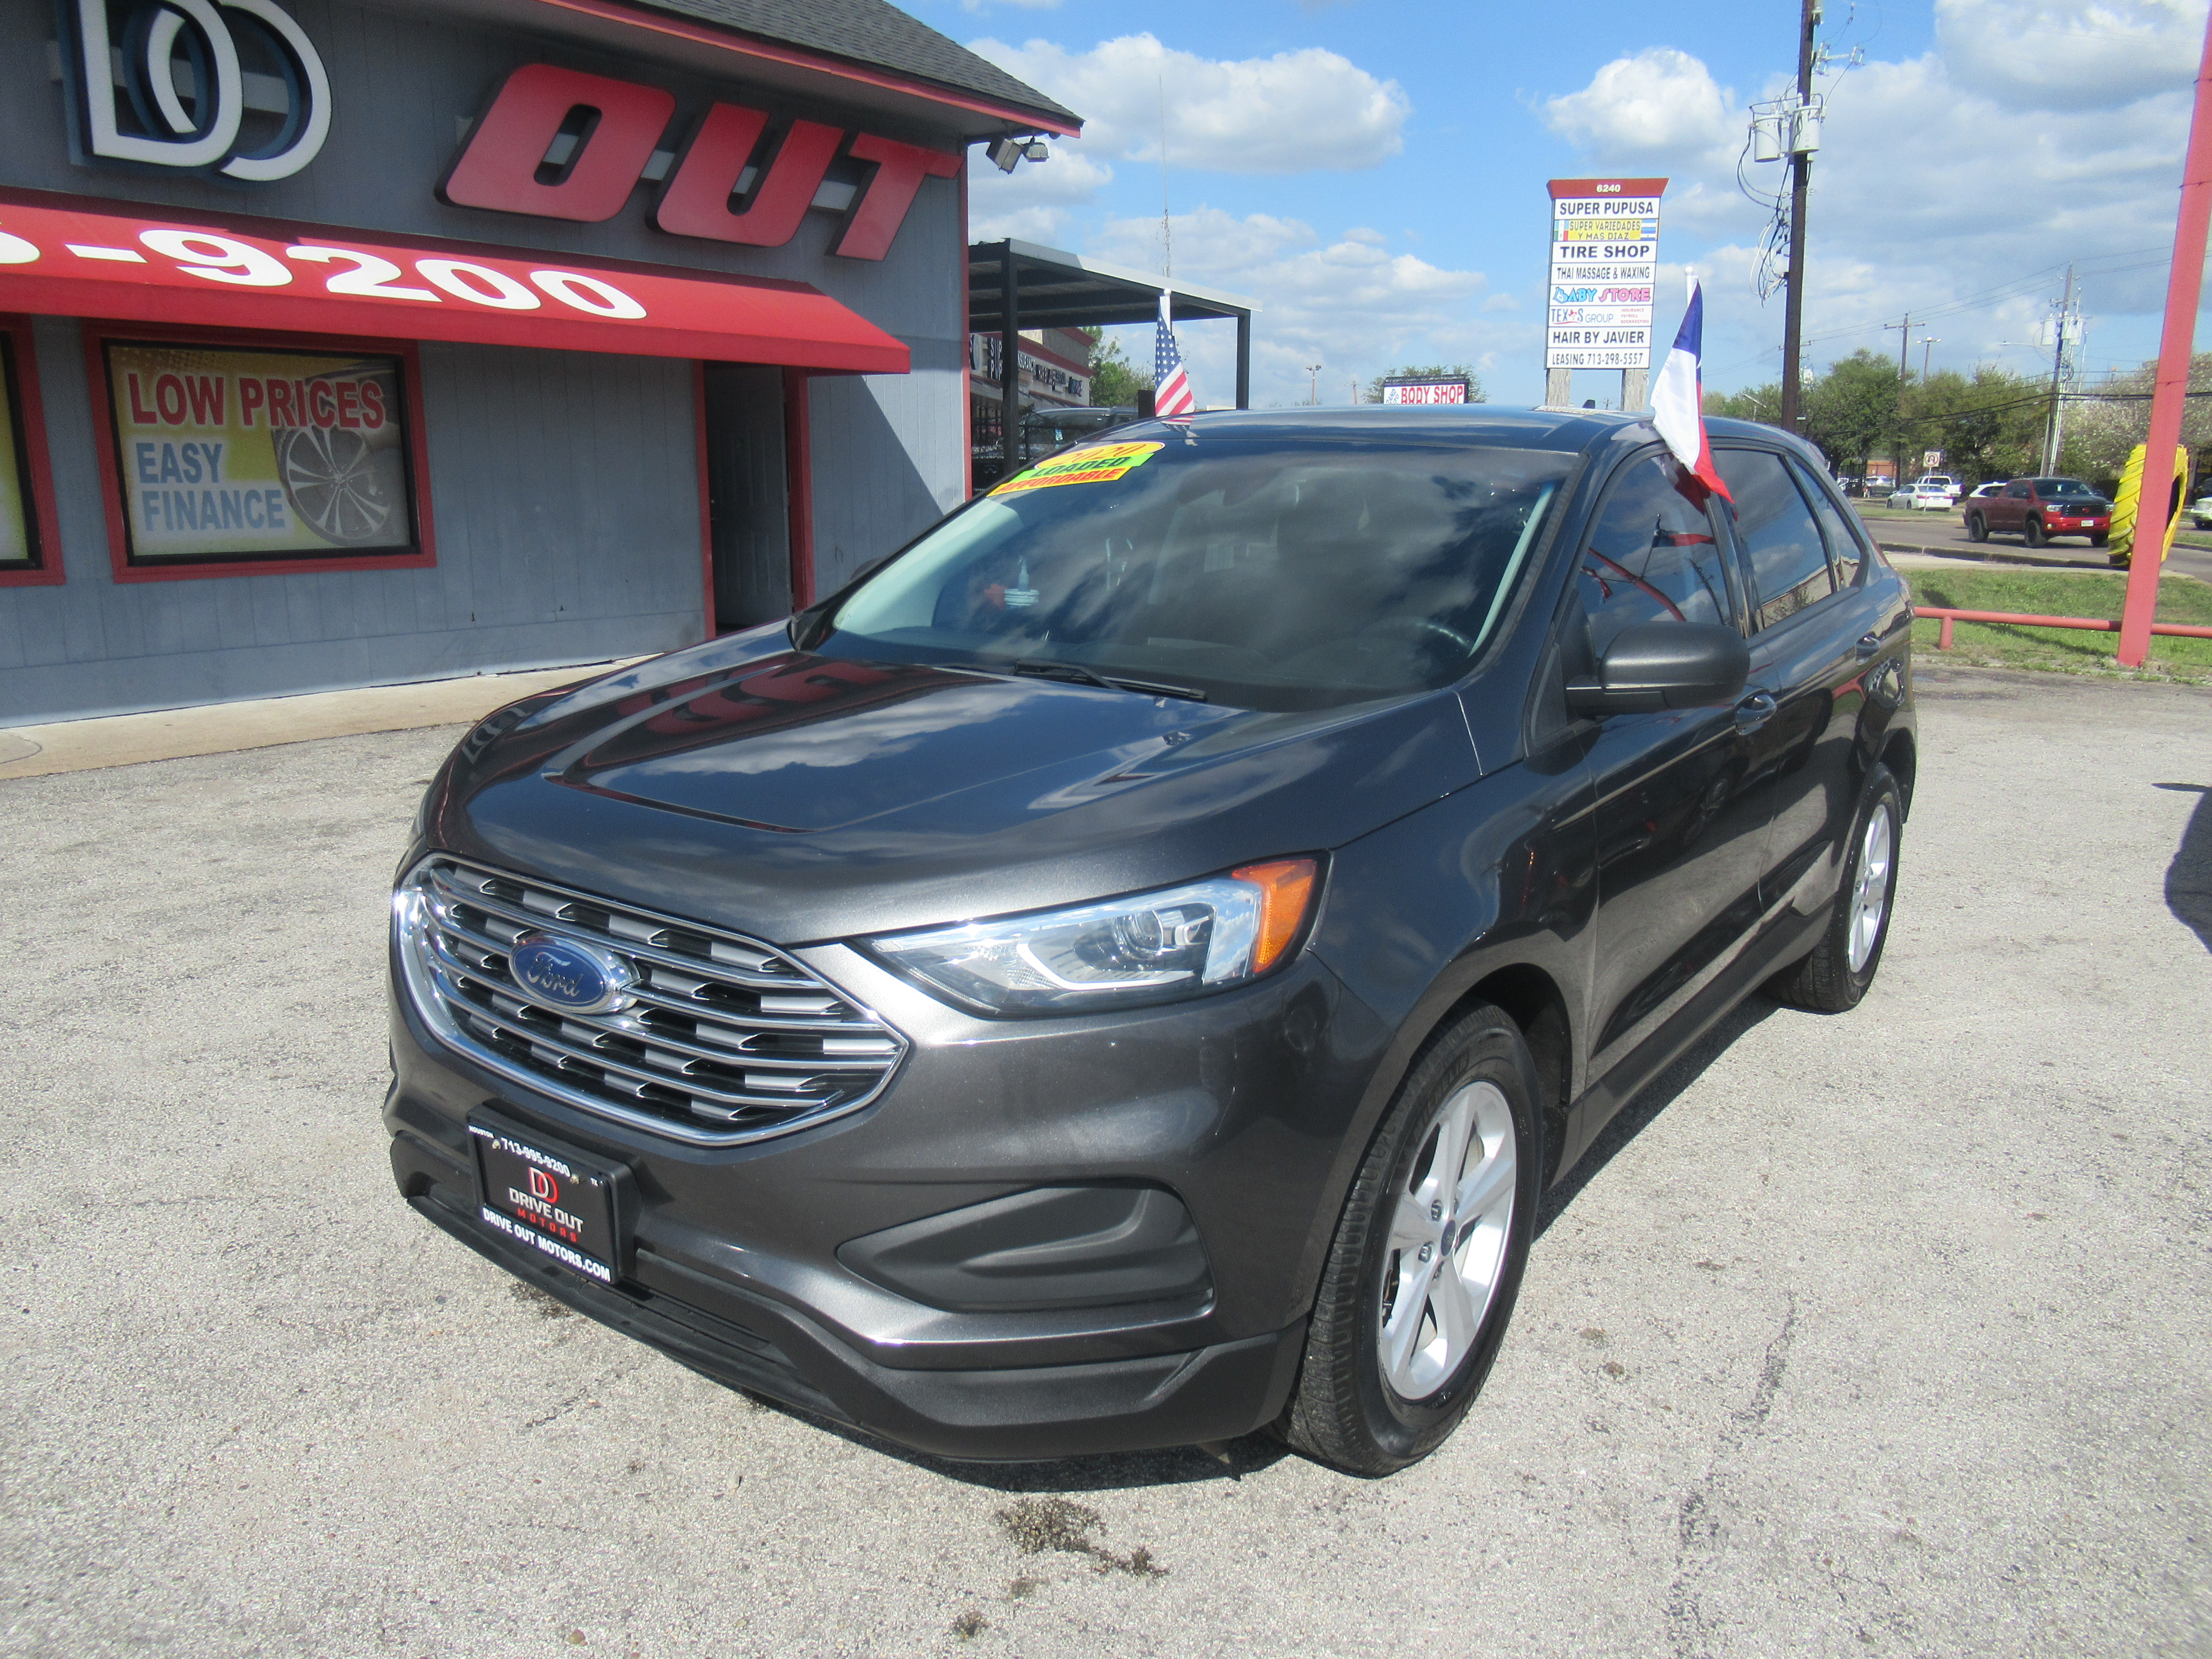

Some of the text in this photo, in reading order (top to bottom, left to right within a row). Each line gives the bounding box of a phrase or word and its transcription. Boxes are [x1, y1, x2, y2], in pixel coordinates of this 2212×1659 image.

[444, 63, 965, 262] OUT
[1596, 184, 1621, 193] 6240
[1560, 202, 1653, 215] SUPER PUPUSA
[1569, 221, 1640, 231] SUPER VARIEDADES
[1560, 245, 1650, 258] TIRE SHOP
[1557, 266, 1650, 279] THAI MASSAGE & WAXING
[1552, 286, 1651, 304] BABY STORE
[1585, 314, 1614, 323] GROUP
[1552, 331, 1644, 343] HAIR BY JAVIER
[1552, 353, 1644, 365] LEASING 713-298-5557
[128, 373, 386, 428] LOW PRICES
[1401, 385, 1464, 404] BODY SHOP
[136, 442, 223, 484] EASY
[1049, 443, 1147, 467] 2020
[1029, 456, 1132, 479] LOADED
[993, 468, 1126, 495] AFFORDABLE
[142, 489, 286, 531] FINANCE
[528, 951, 584, 997] Ford
[469, 1125, 495, 1138] HOUSTON
[500, 1137, 572, 1178] 713-995-9200
[590, 1176, 599, 1187] TX
[509, 1187, 584, 1233] DRIVE OUT
[517, 1208, 578, 1242] MOTORS
[482, 1207, 612, 1282] DRIVE OUT MOTORS.COM
